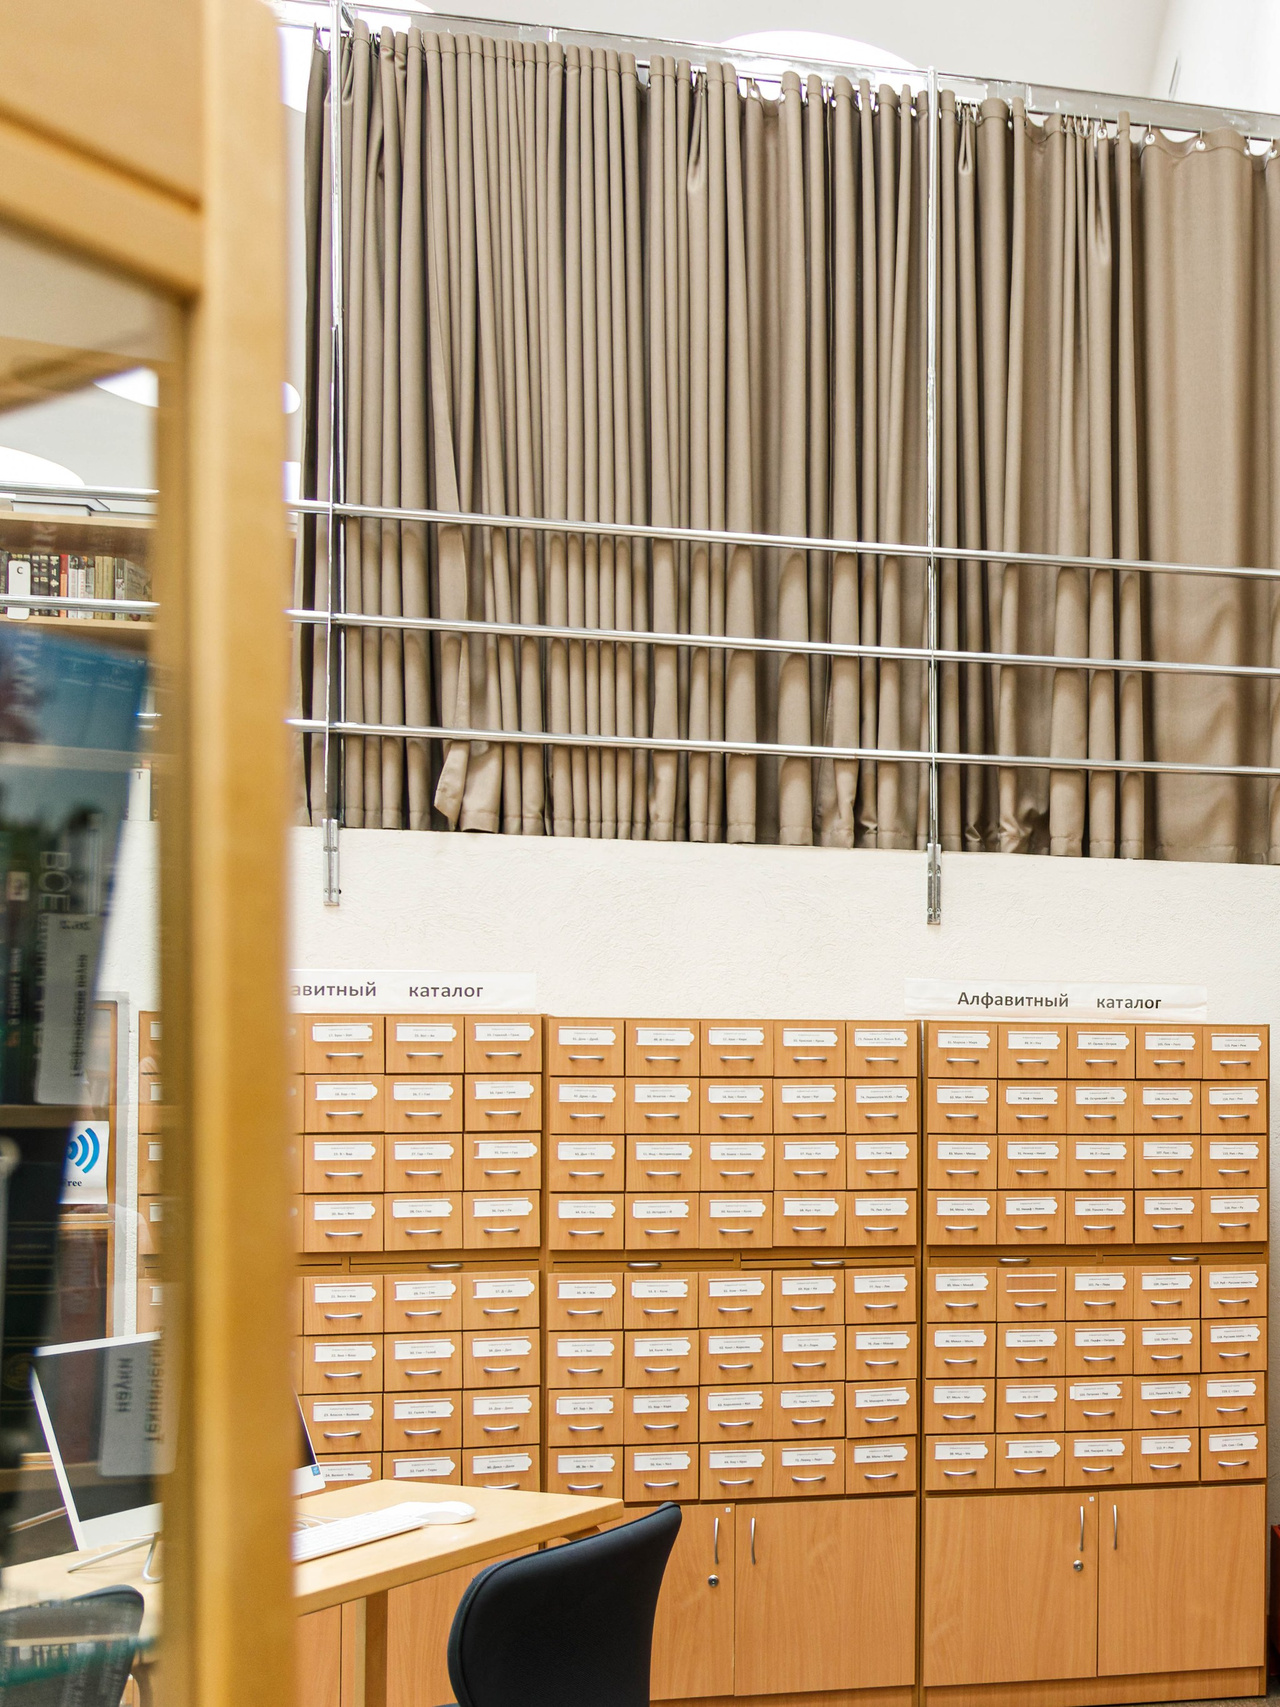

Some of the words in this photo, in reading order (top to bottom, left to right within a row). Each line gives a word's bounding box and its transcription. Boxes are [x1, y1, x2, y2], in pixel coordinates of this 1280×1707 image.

[409, 986, 484, 997] каталог
[958, 991, 1069, 1008] Алфавитный
[1097, 996, 1162, 1009] каталог
